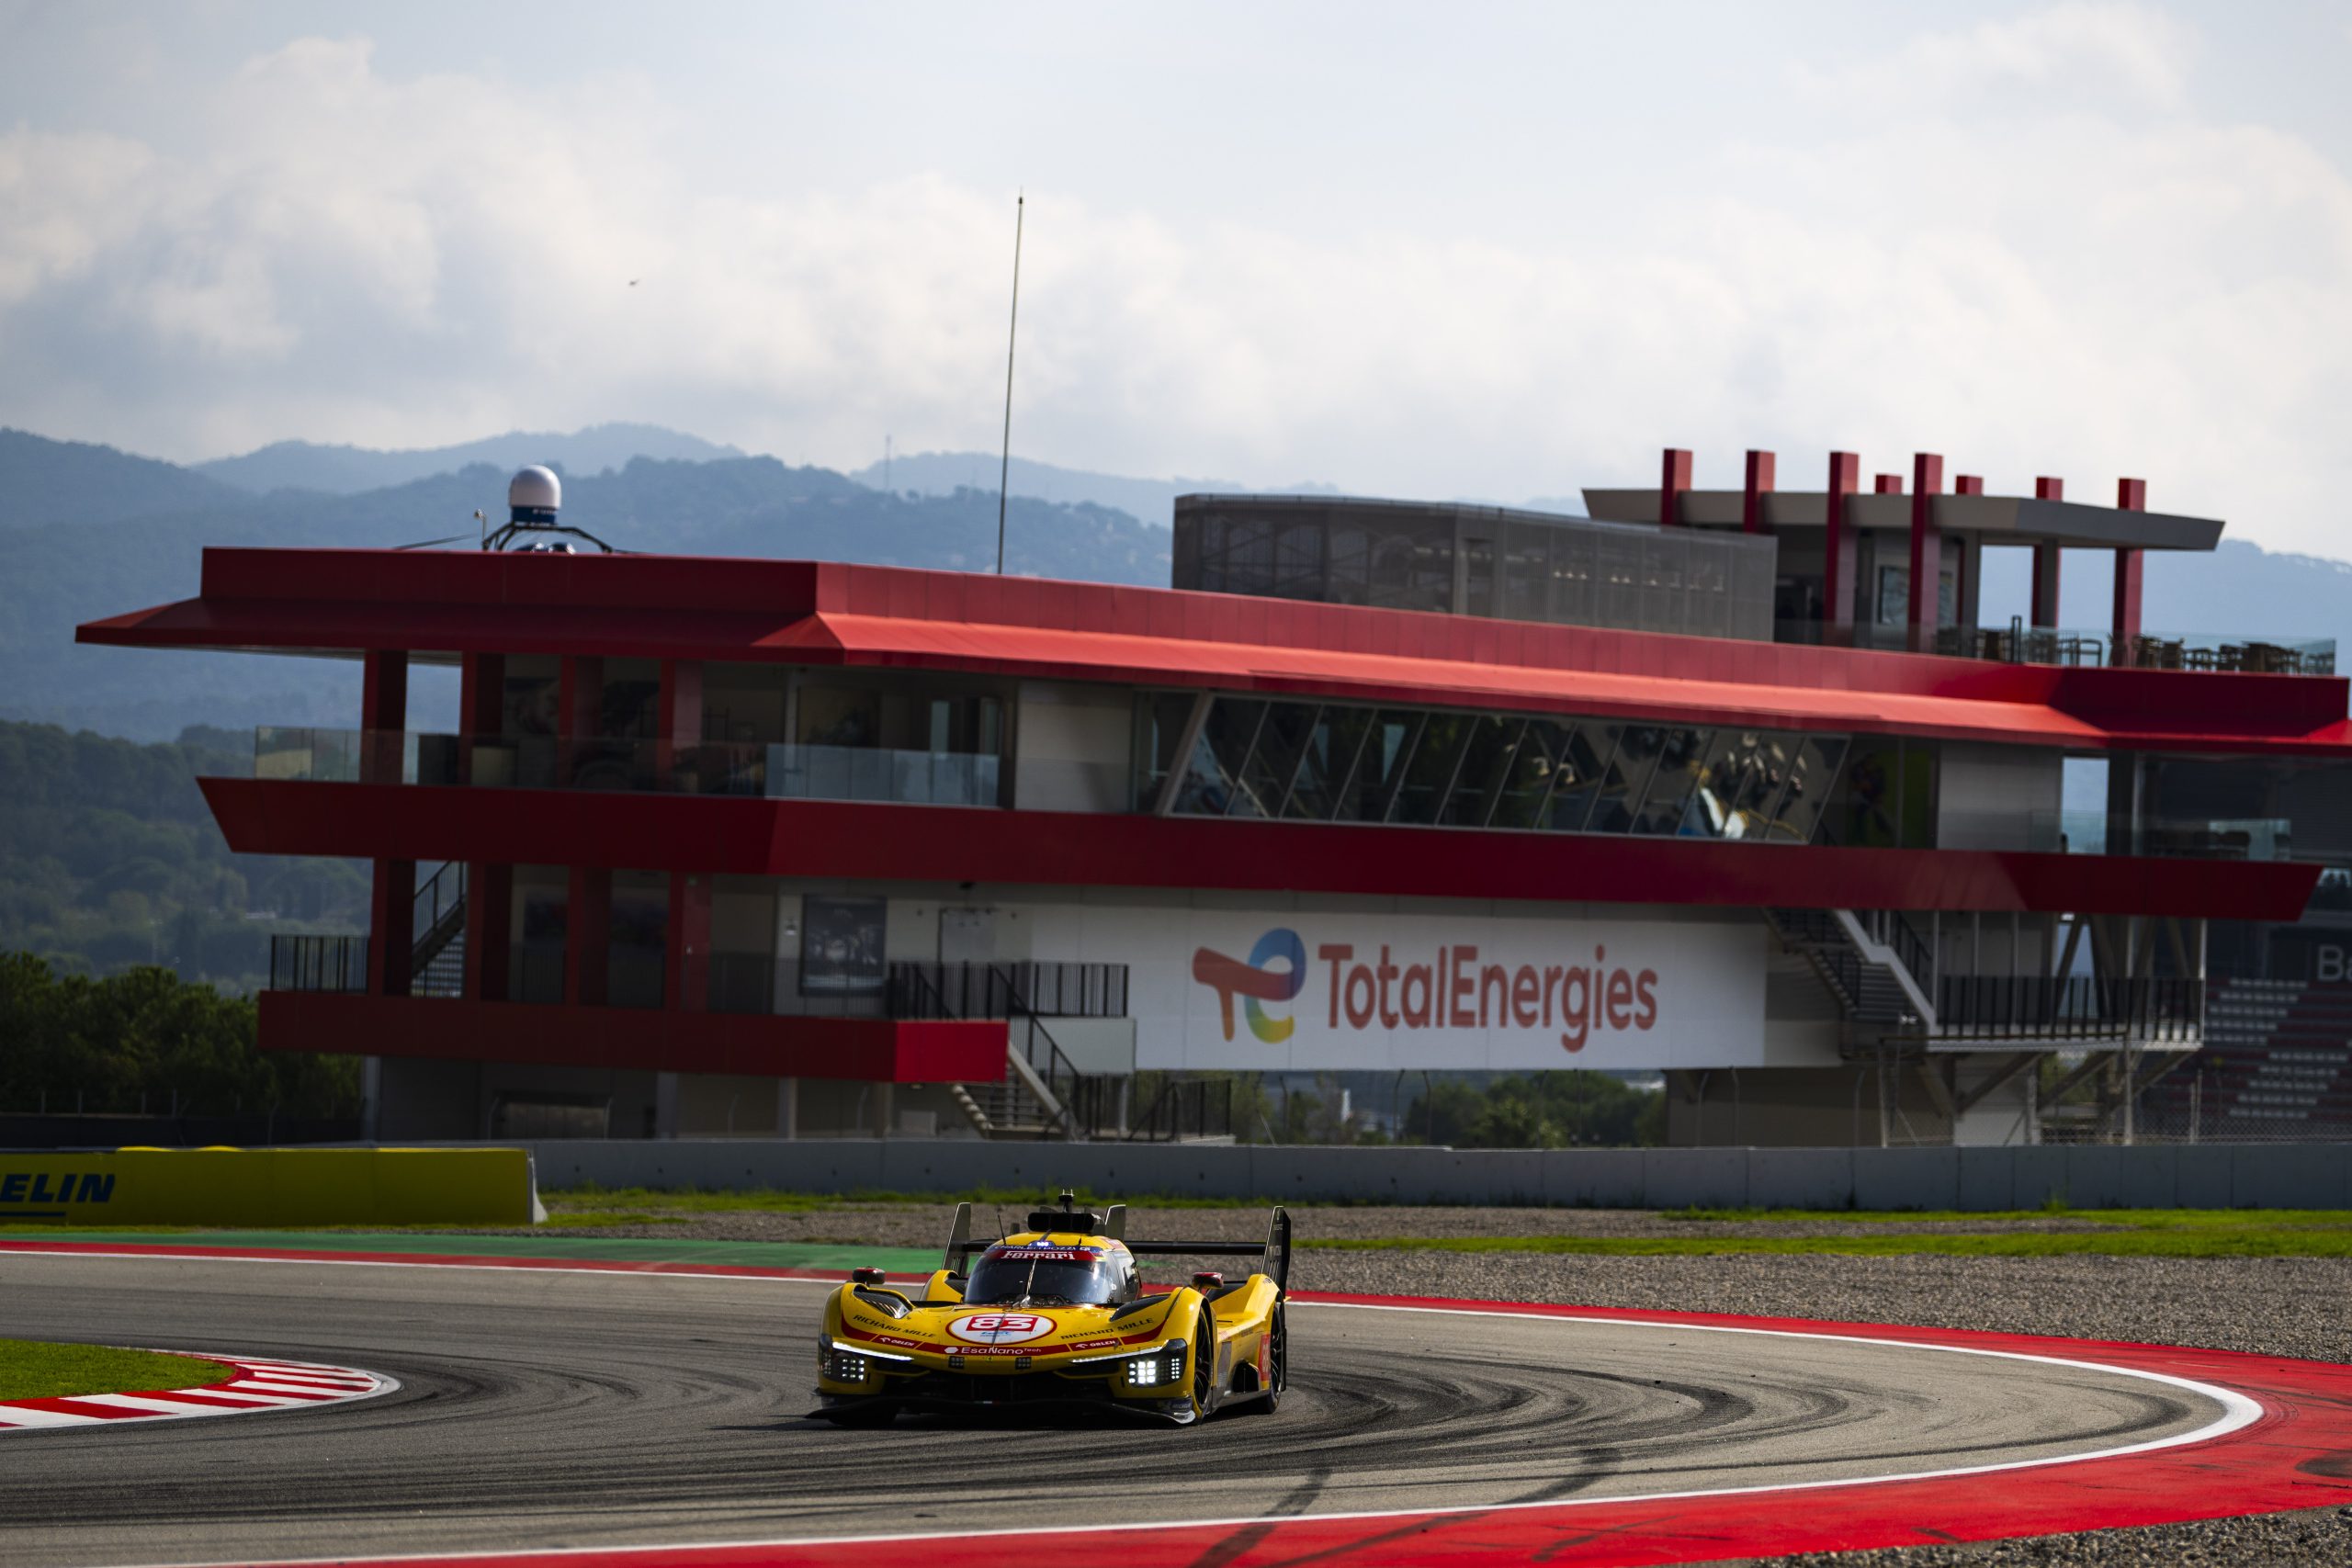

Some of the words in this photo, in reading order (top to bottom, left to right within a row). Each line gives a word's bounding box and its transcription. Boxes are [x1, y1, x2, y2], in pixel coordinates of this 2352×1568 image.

[1317, 943, 1658, 1053] TotalEnergies
[1001, 1250, 1076, 1260] Ferrari
[853, 1314, 900, 1332] RICHARD
[903, 1328, 936, 1338] MILLE
[970, 1316, 1037, 1331] 83
[1060, 1328, 1114, 1340] RICHARD
[1117, 1318, 1155, 1332] MILLE
[890, 1338, 915, 1347] ORLEN
[1090, 1339, 1116, 1348] ORLEN
